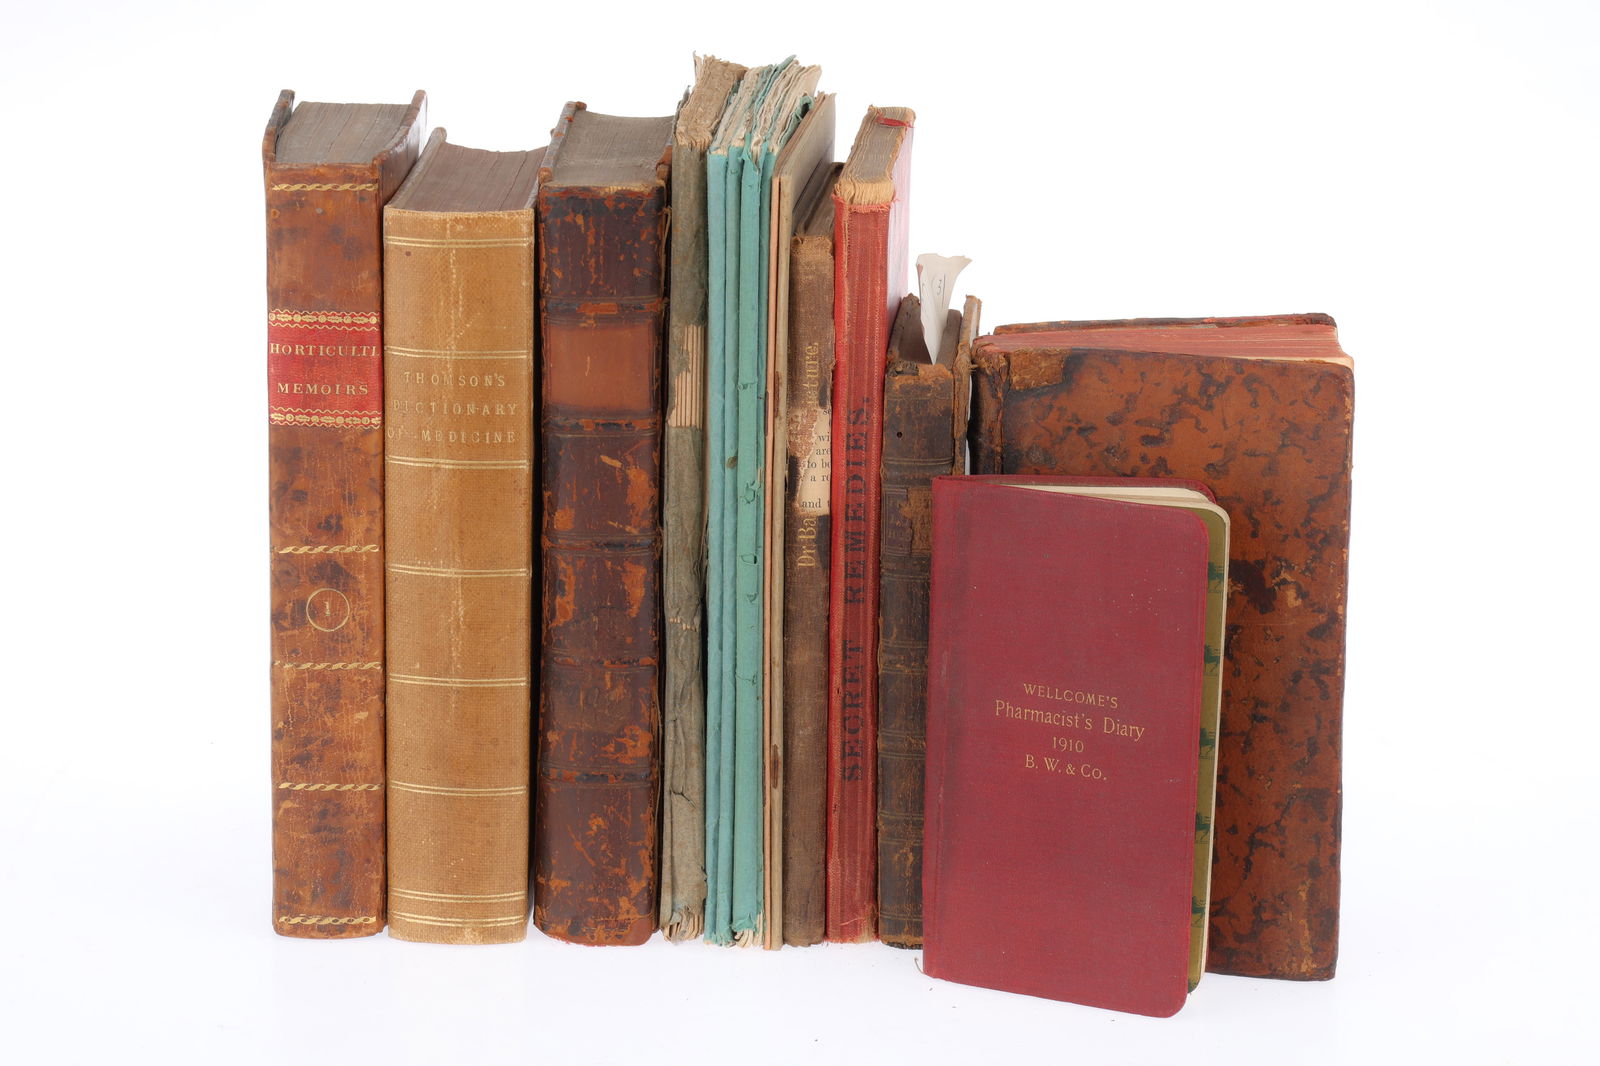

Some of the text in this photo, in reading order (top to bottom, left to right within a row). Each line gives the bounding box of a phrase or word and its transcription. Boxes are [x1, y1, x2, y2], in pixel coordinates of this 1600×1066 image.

[403, 371, 506, 388] THOMSON'S
[277, 383, 369, 395] MEMOIRS
[393, 399, 519, 416] DICTIONARY
[421, 429, 516, 444] MEDICINE
[810, 474, 817, 482] a
[801, 498, 822, 509] and
[797, 545, 817, 569] Dr
[1023, 683, 1119, 709] WELLCOME'S
[842, 639, 865, 782] SECRET
[995, 700, 1145, 742] Pharmacist's Diary
[1052, 736, 1085, 753] 1910
[1025, 754, 1107, 781] B. W. & Co.
